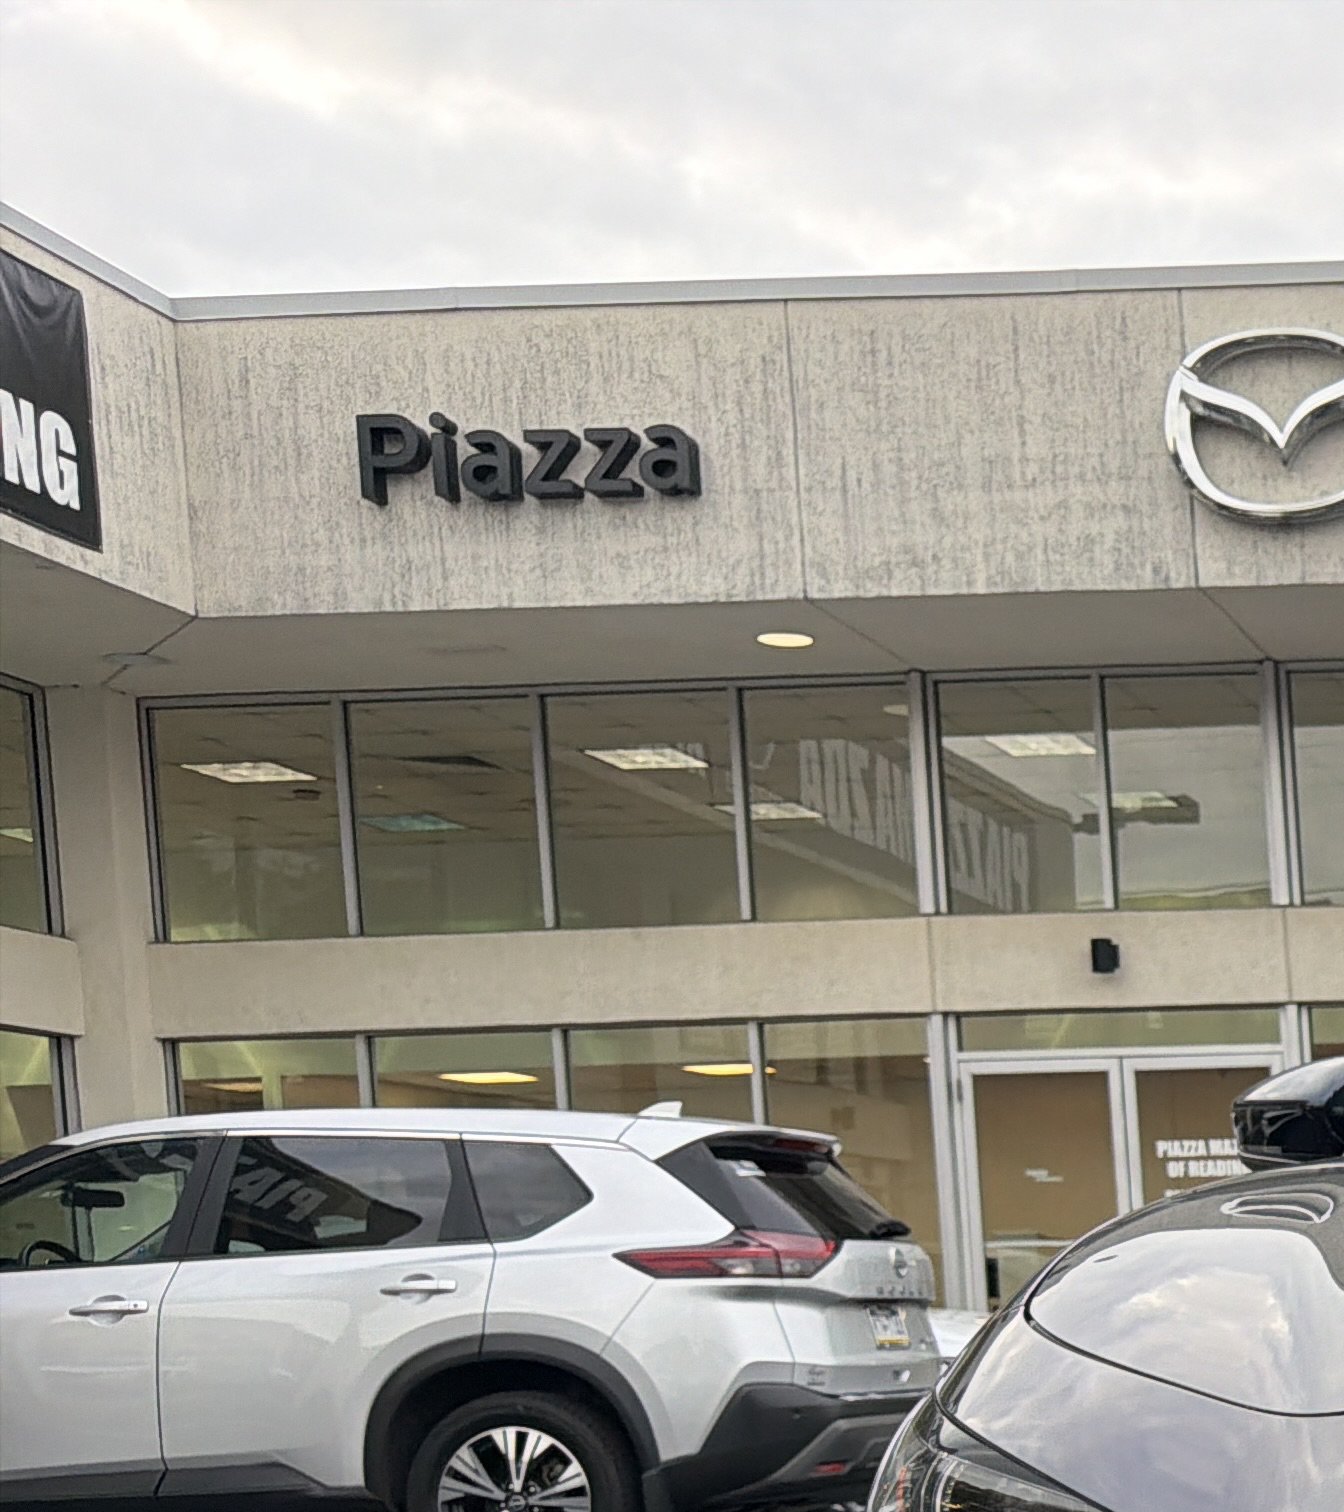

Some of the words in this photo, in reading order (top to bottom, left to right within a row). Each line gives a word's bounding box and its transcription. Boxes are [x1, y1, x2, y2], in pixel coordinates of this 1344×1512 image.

[356, 412, 702, 506] Piazza
[1156, 1138, 1208, 1158] PIAZZA
[1209, 1137, 1238, 1156] MAZ
[1167, 1160, 1185, 1178] OF
